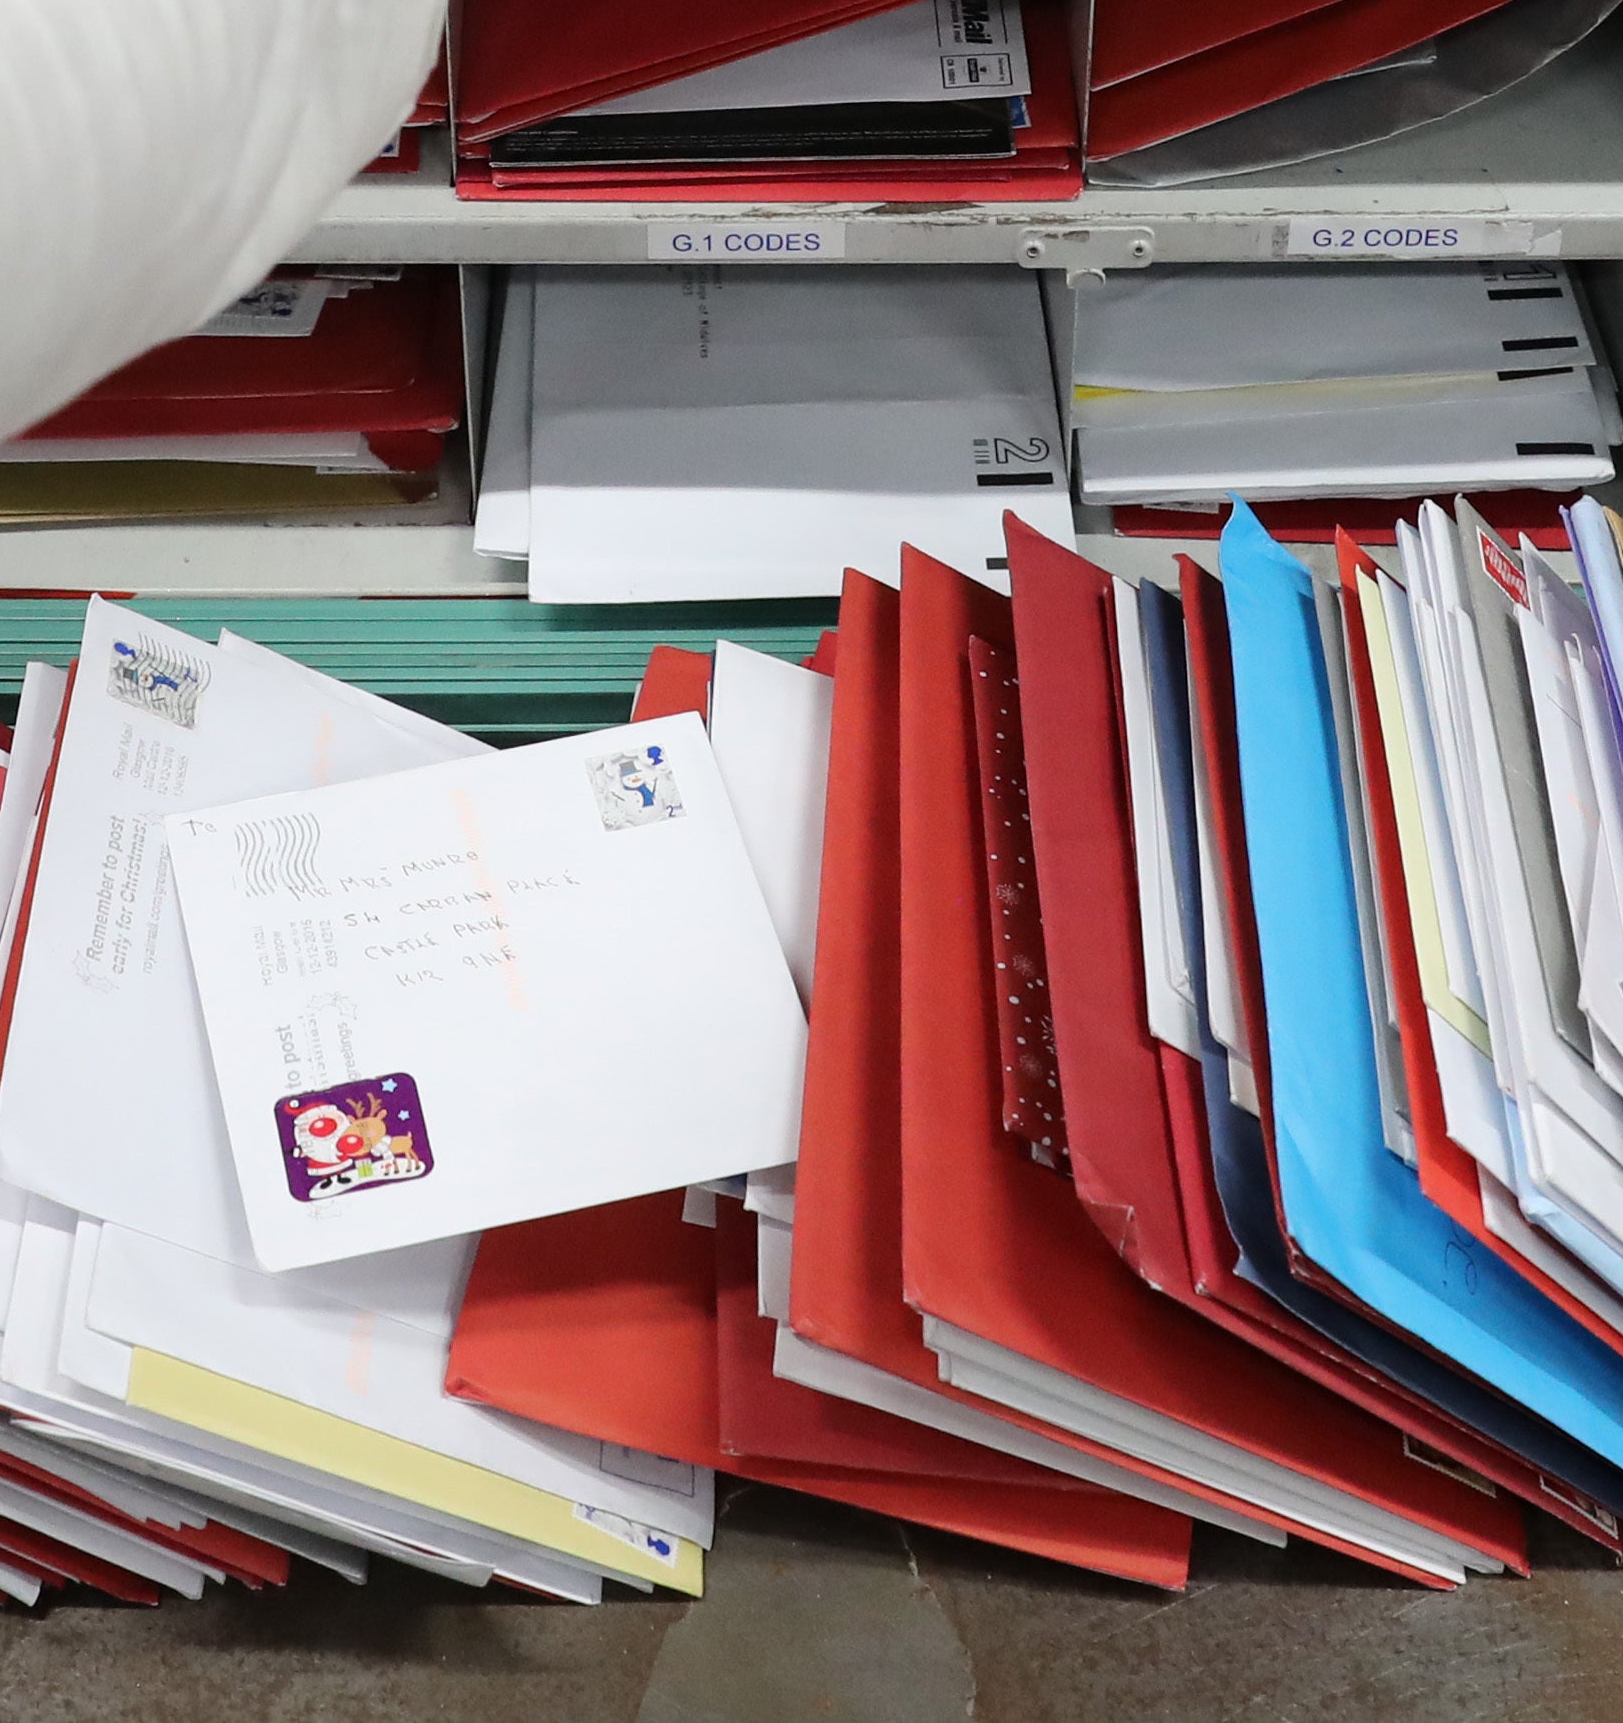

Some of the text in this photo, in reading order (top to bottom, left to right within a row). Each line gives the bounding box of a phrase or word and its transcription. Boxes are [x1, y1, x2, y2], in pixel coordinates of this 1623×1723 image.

[672, 233, 820, 252] G.1 CODES
[1312, 228, 1458, 247] G.2 CODES
[993, 437, 1050, 465] 2
[85, 814, 126, 963] Remember to post
